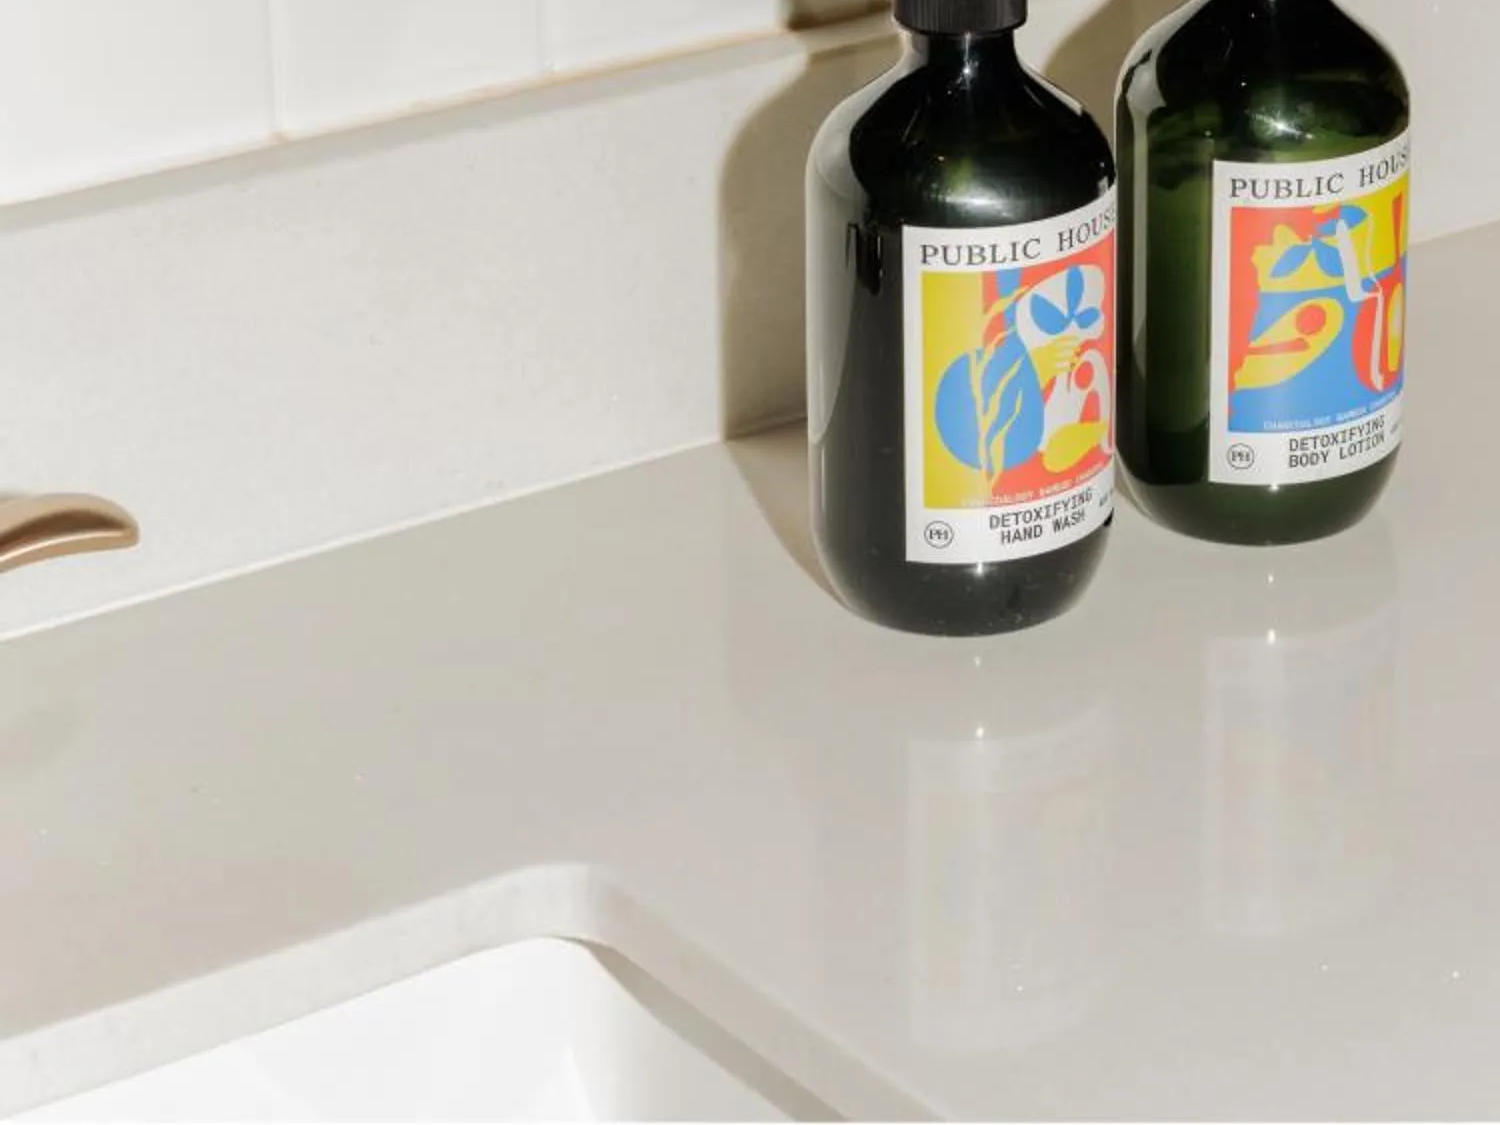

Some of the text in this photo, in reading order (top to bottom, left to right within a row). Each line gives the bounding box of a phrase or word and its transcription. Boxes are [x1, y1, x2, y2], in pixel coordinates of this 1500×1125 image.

[1230, 137, 1410, 200] PUBLIC HOUS
[920, 202, 1116, 266] PUBLIC HOUS
[1289, 414, 1386, 452] DETOXIFYING
[1289, 433, 1386, 468] BODY LOTION
[989, 487, 1093, 530] DETOXIFYING
[1001, 512, 1086, 545] HAND WASH
